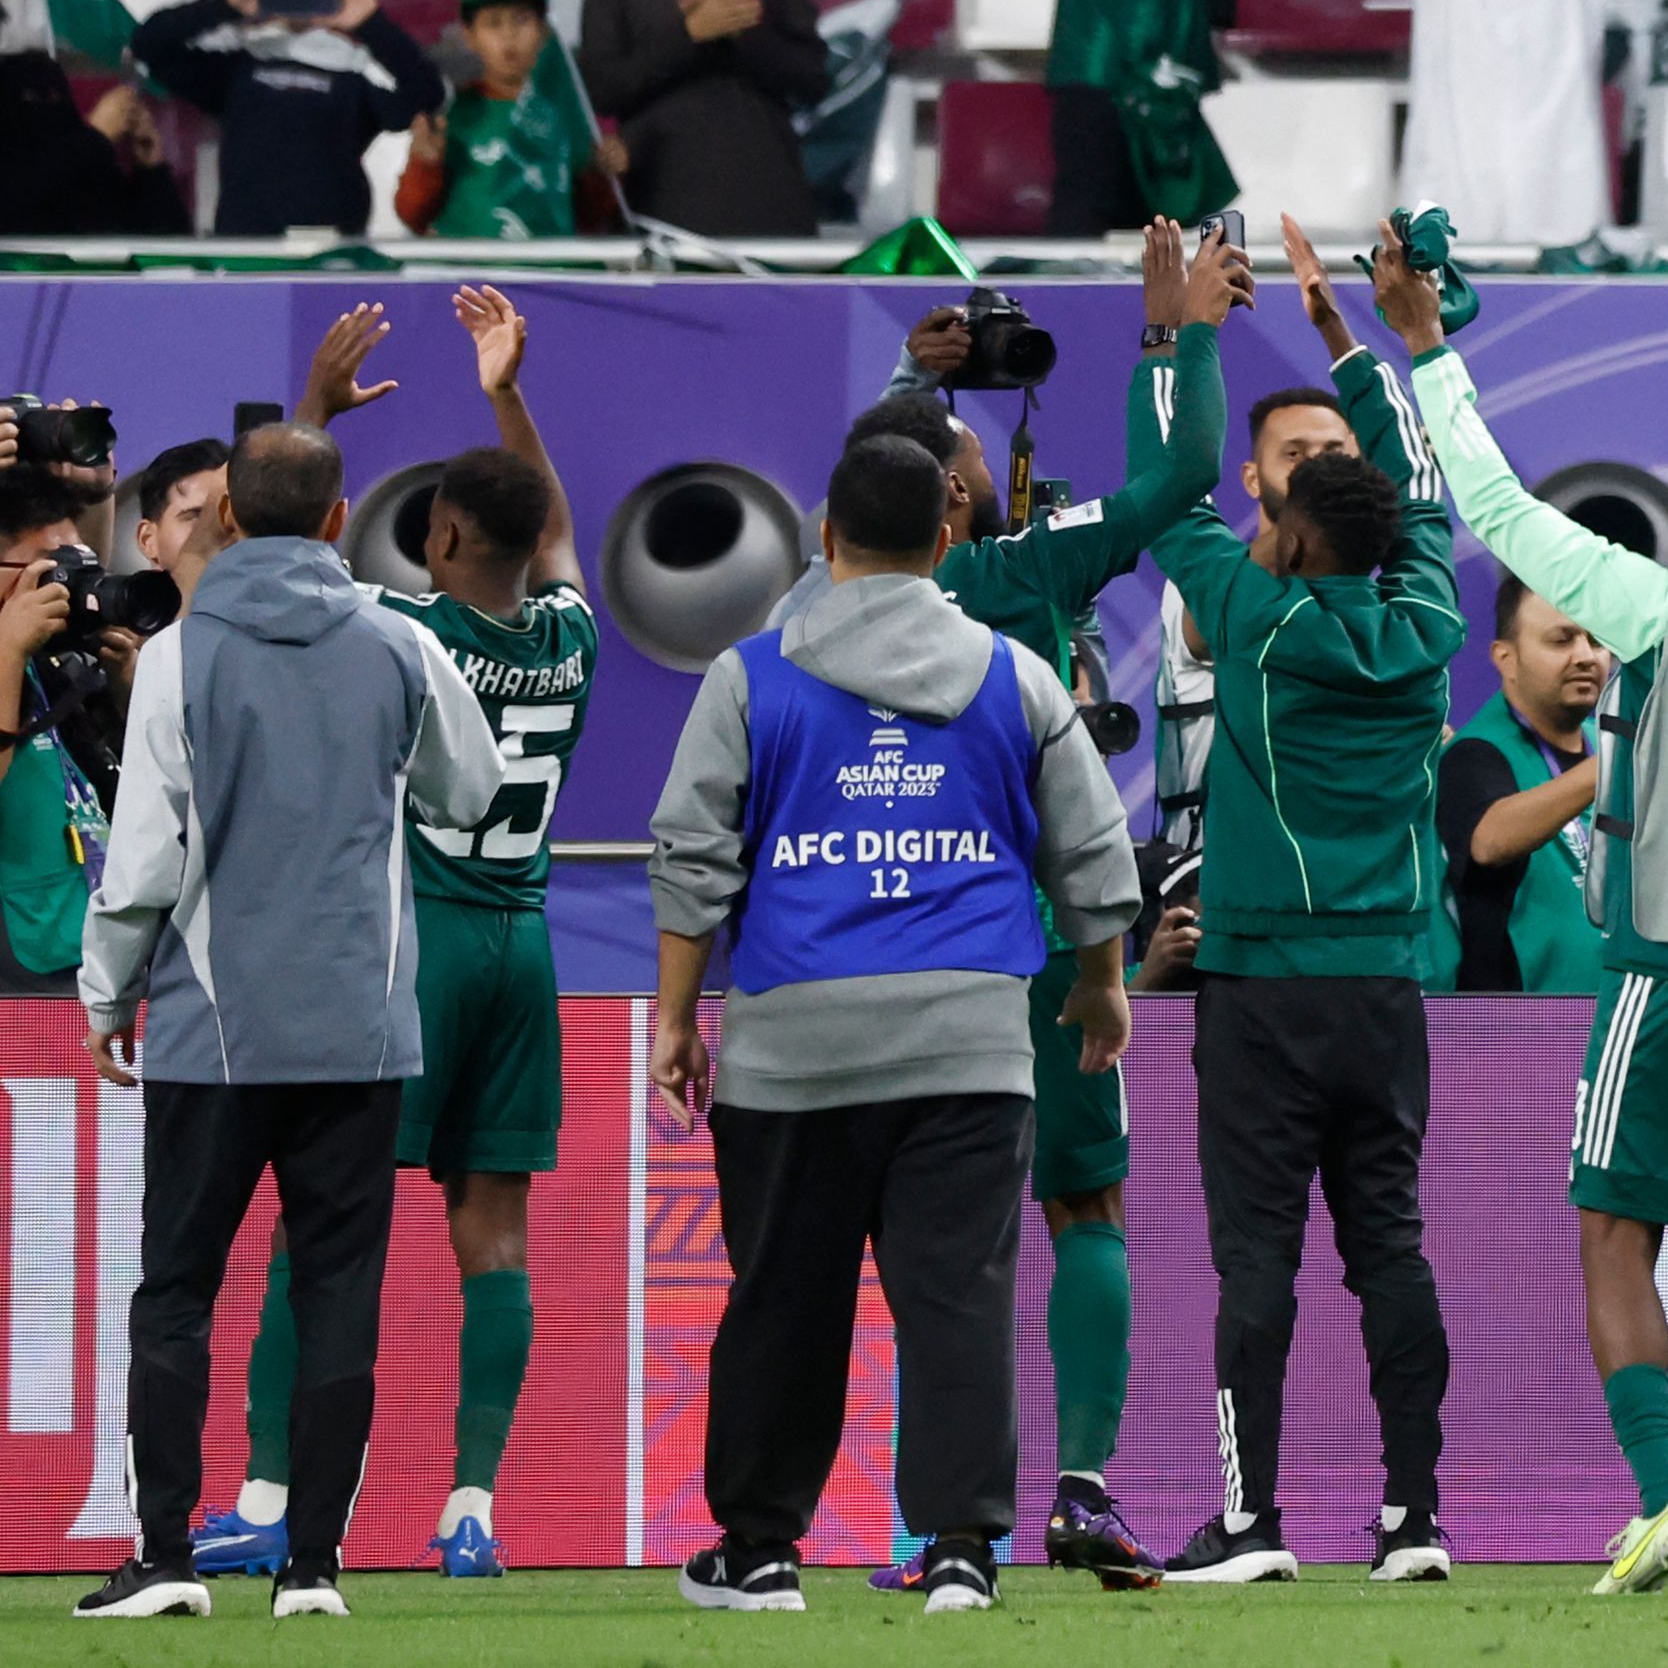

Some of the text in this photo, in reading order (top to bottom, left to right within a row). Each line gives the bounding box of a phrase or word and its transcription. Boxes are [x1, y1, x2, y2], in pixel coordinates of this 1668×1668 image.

[874, 750, 904, 764] AFC
[835, 764, 946, 783] ASIAN CUP
[841, 782, 937, 800] QATAR 2023
[771, 829, 996, 868] AFC DIGITAL
[869, 867, 911, 898] 12
